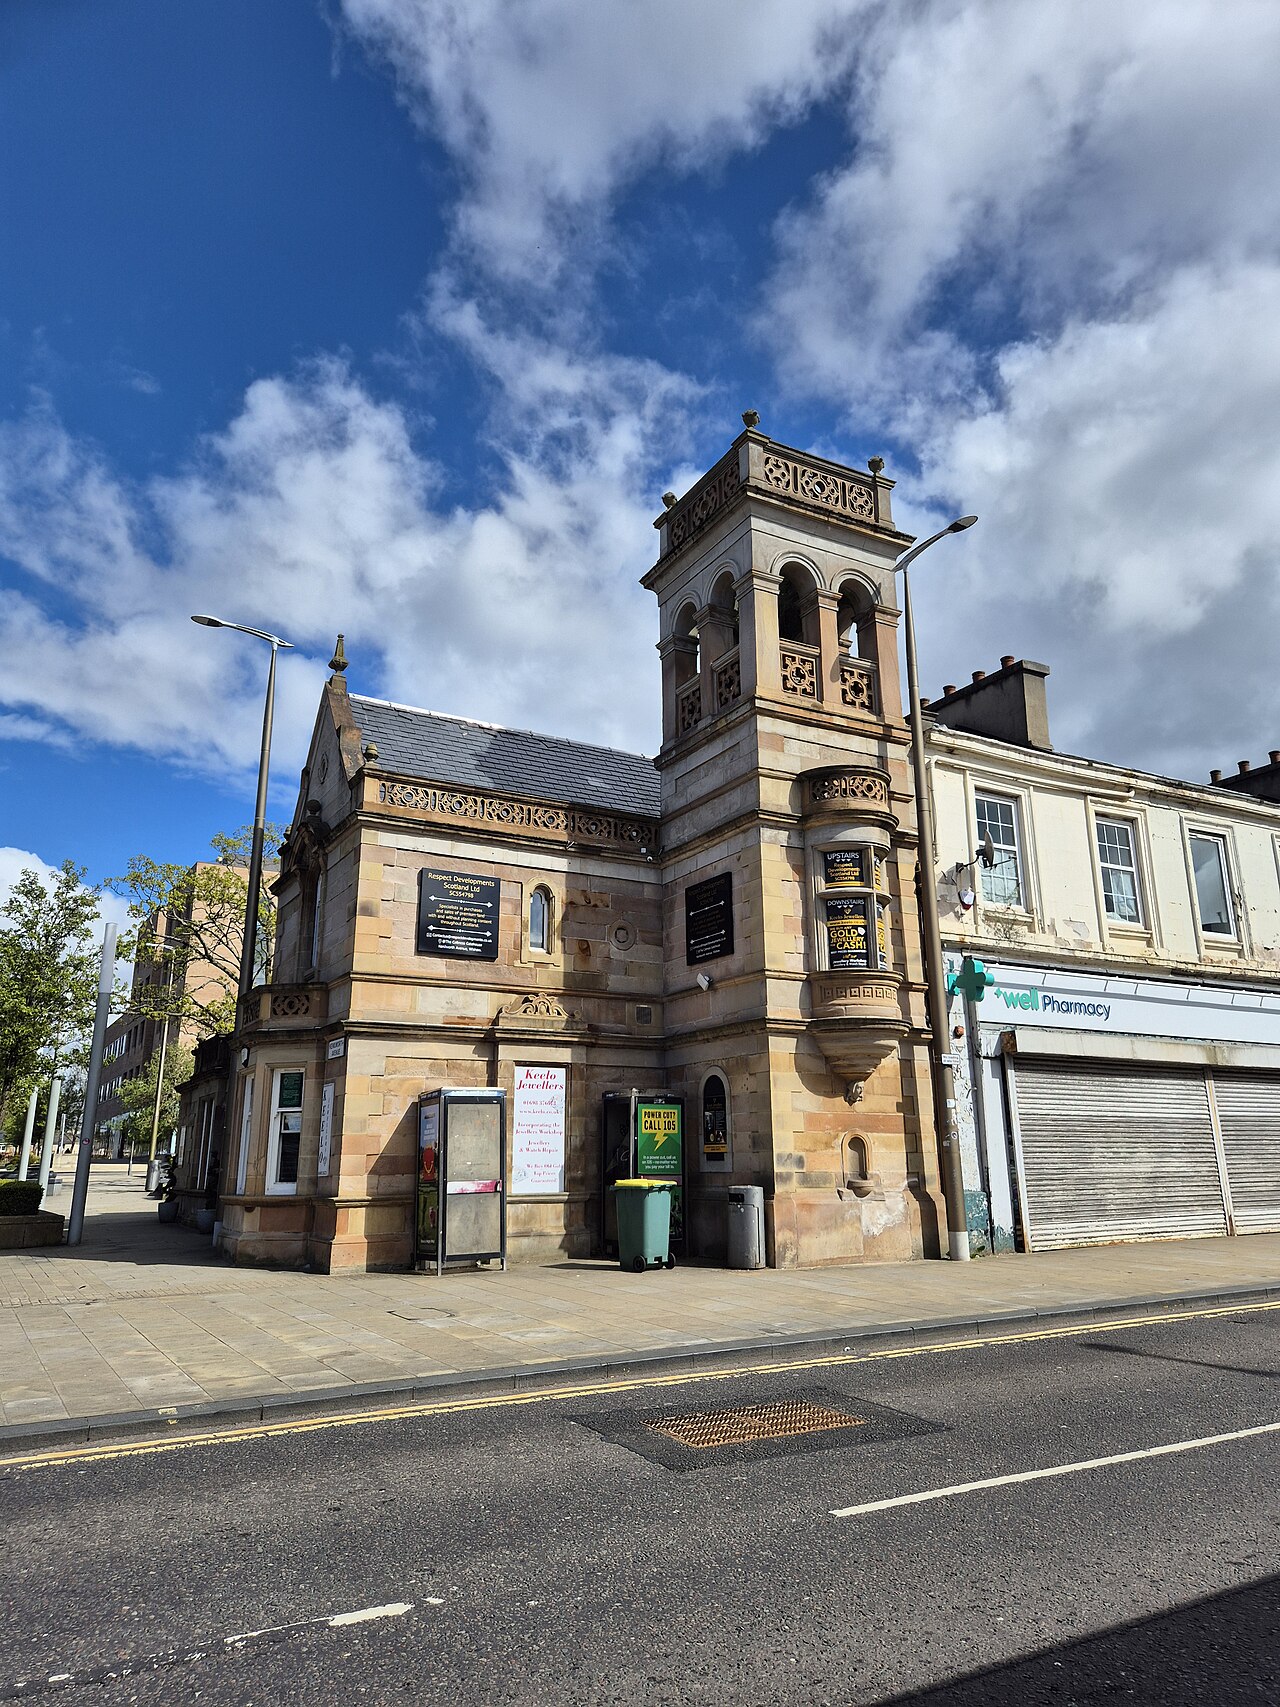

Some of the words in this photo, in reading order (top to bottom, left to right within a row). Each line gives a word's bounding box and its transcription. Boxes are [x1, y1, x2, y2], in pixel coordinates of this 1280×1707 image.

[428, 872, 452, 881] Respect
[454, 876, 495, 887] Developments
[444, 882, 468, 891] Scotland
[830, 929, 858, 938] GOLD
[836, 941, 866, 950] CASH!
[1003, 987, 1039, 1011] well
[1042, 995, 1110, 1021] Pharmacy
[525, 1070, 556, 1080] Keelo
[516, 1080, 564, 1090] Jewellers
[644, 1120, 661, 1130] CALL
[664, 1120, 676, 1130] 105
